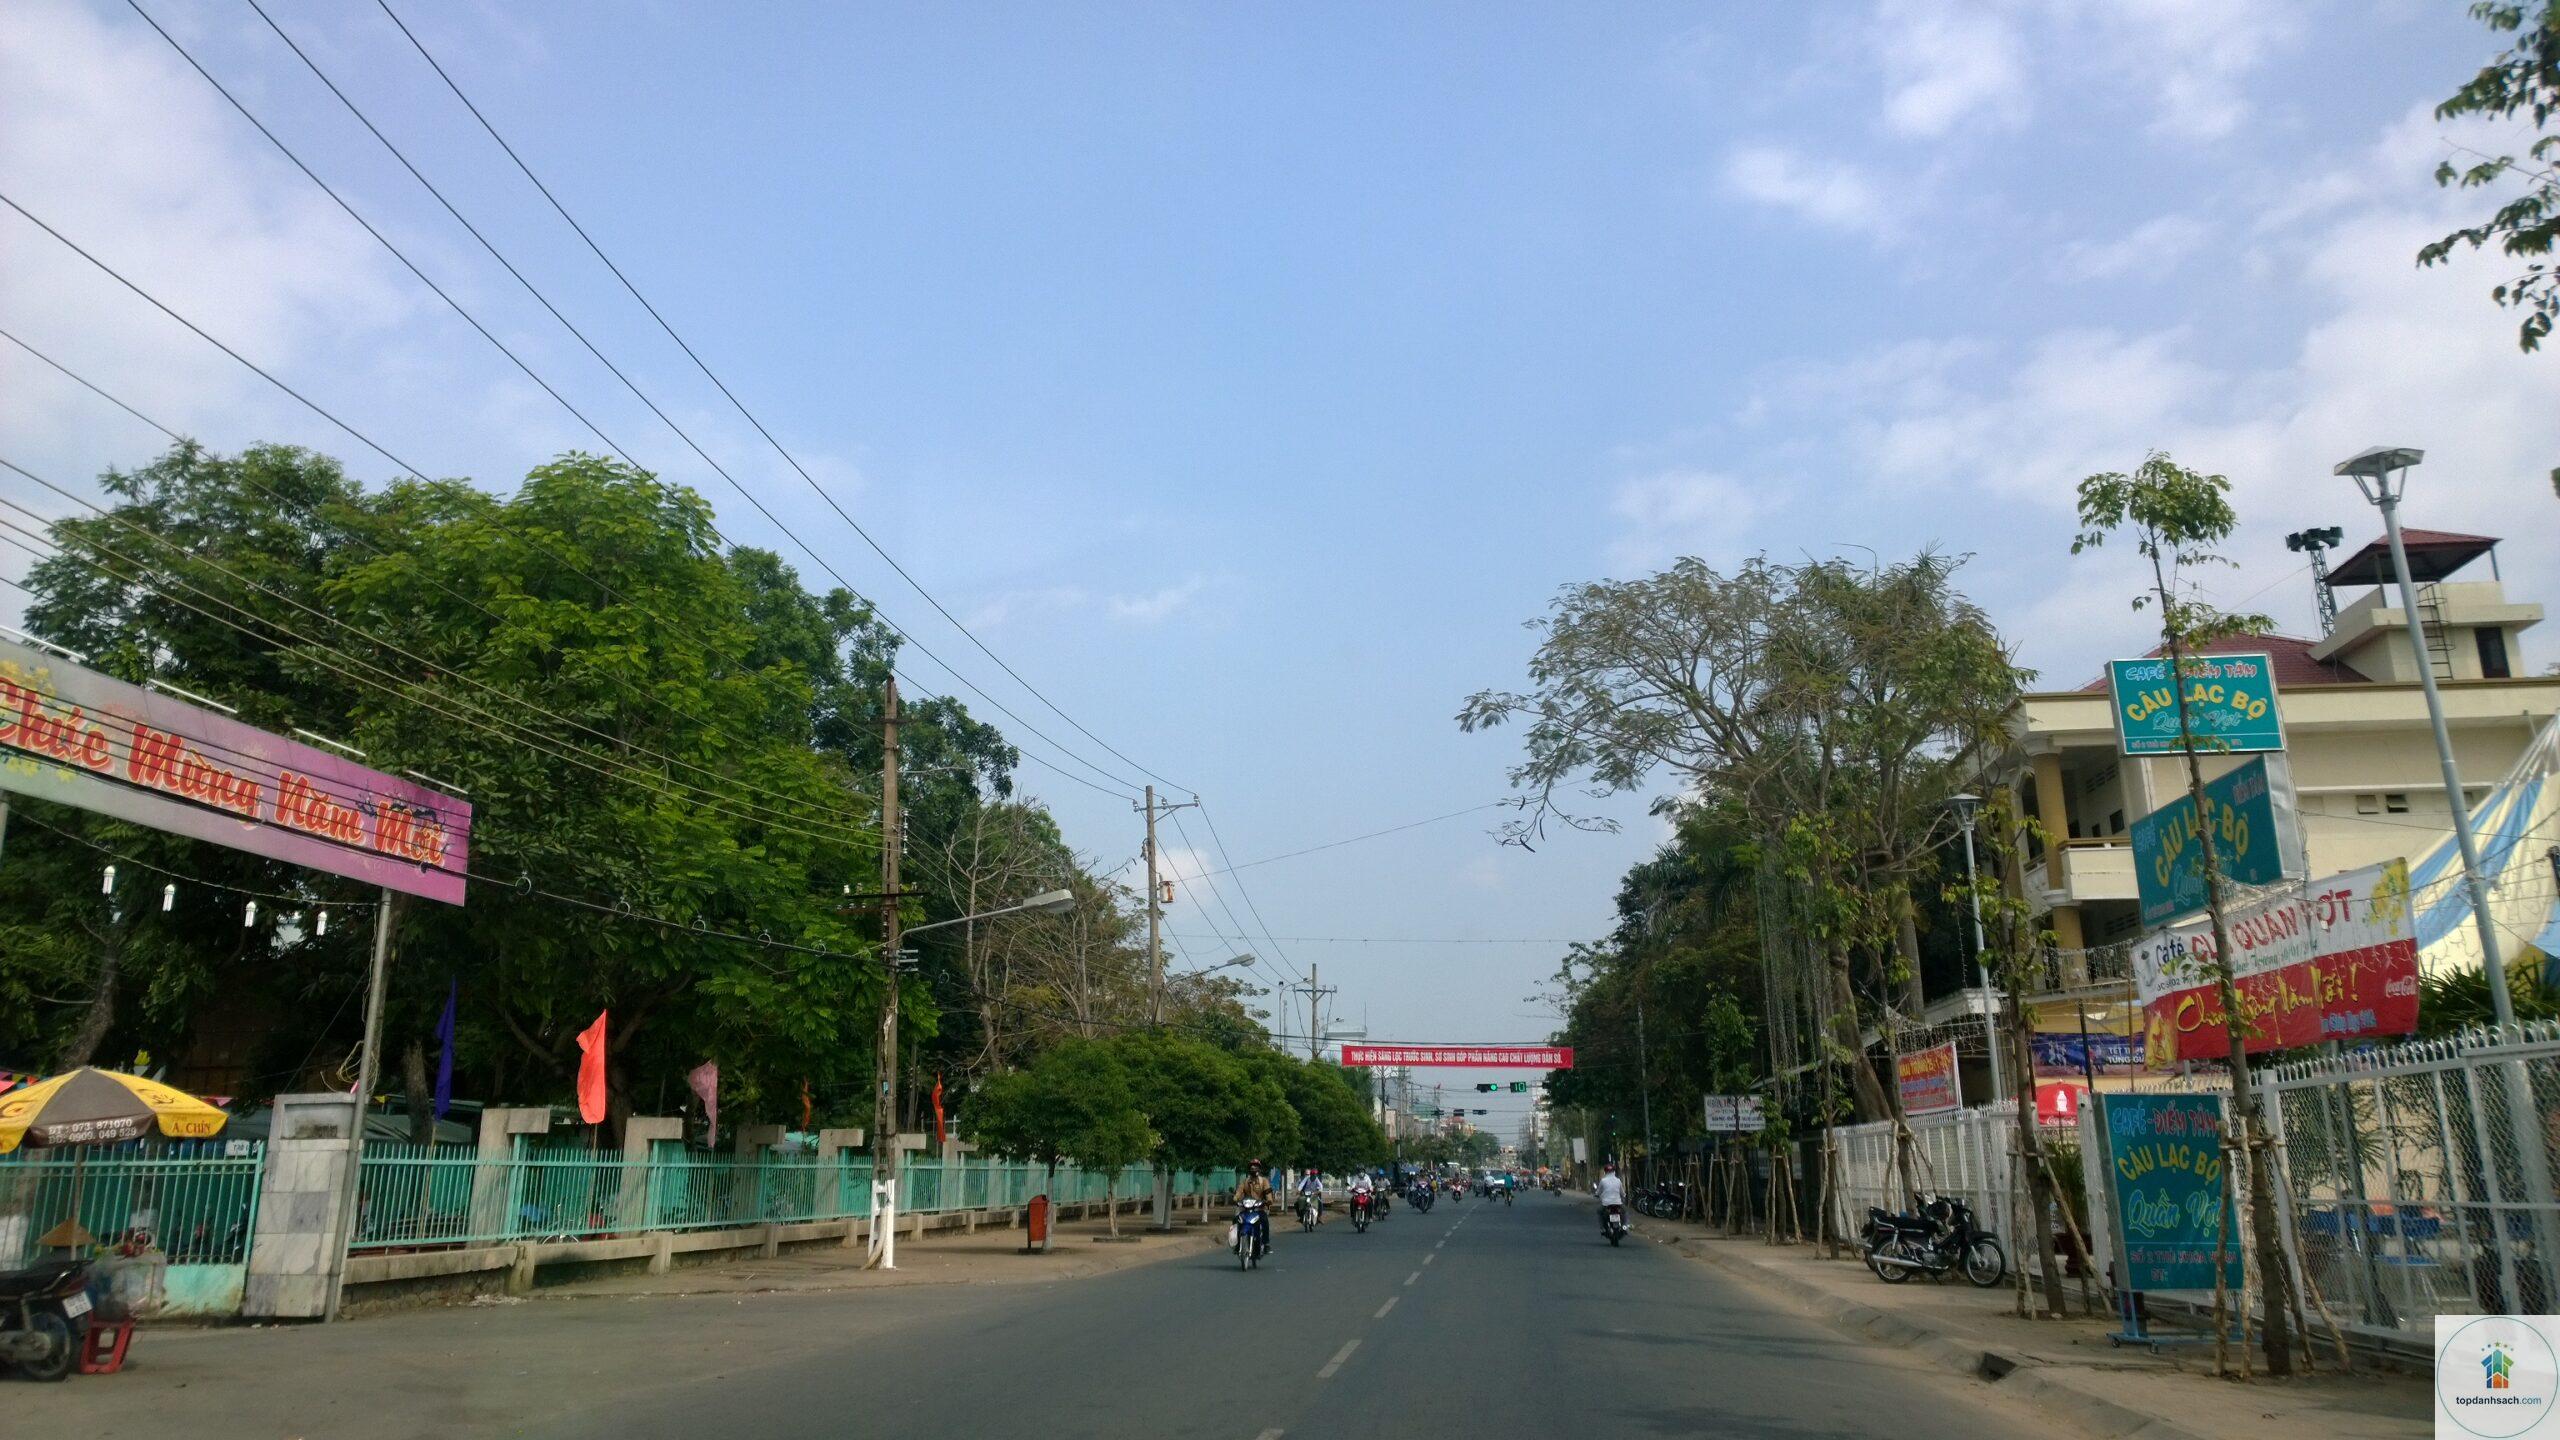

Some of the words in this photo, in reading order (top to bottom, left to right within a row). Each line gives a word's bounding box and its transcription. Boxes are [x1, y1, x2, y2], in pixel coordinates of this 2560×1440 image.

[2223, 661, 2258, 679] TÂM
[2127, 687, 2173, 721] CÂU
[2231, 690, 2267, 721] BỘ
[126, 723, 262, 830] Mừng
[274, 770, 364, 843] Năm
[2117, 1144, 2155, 1181] CÂU
[2156, 1142, 2190, 1173] LẠC
